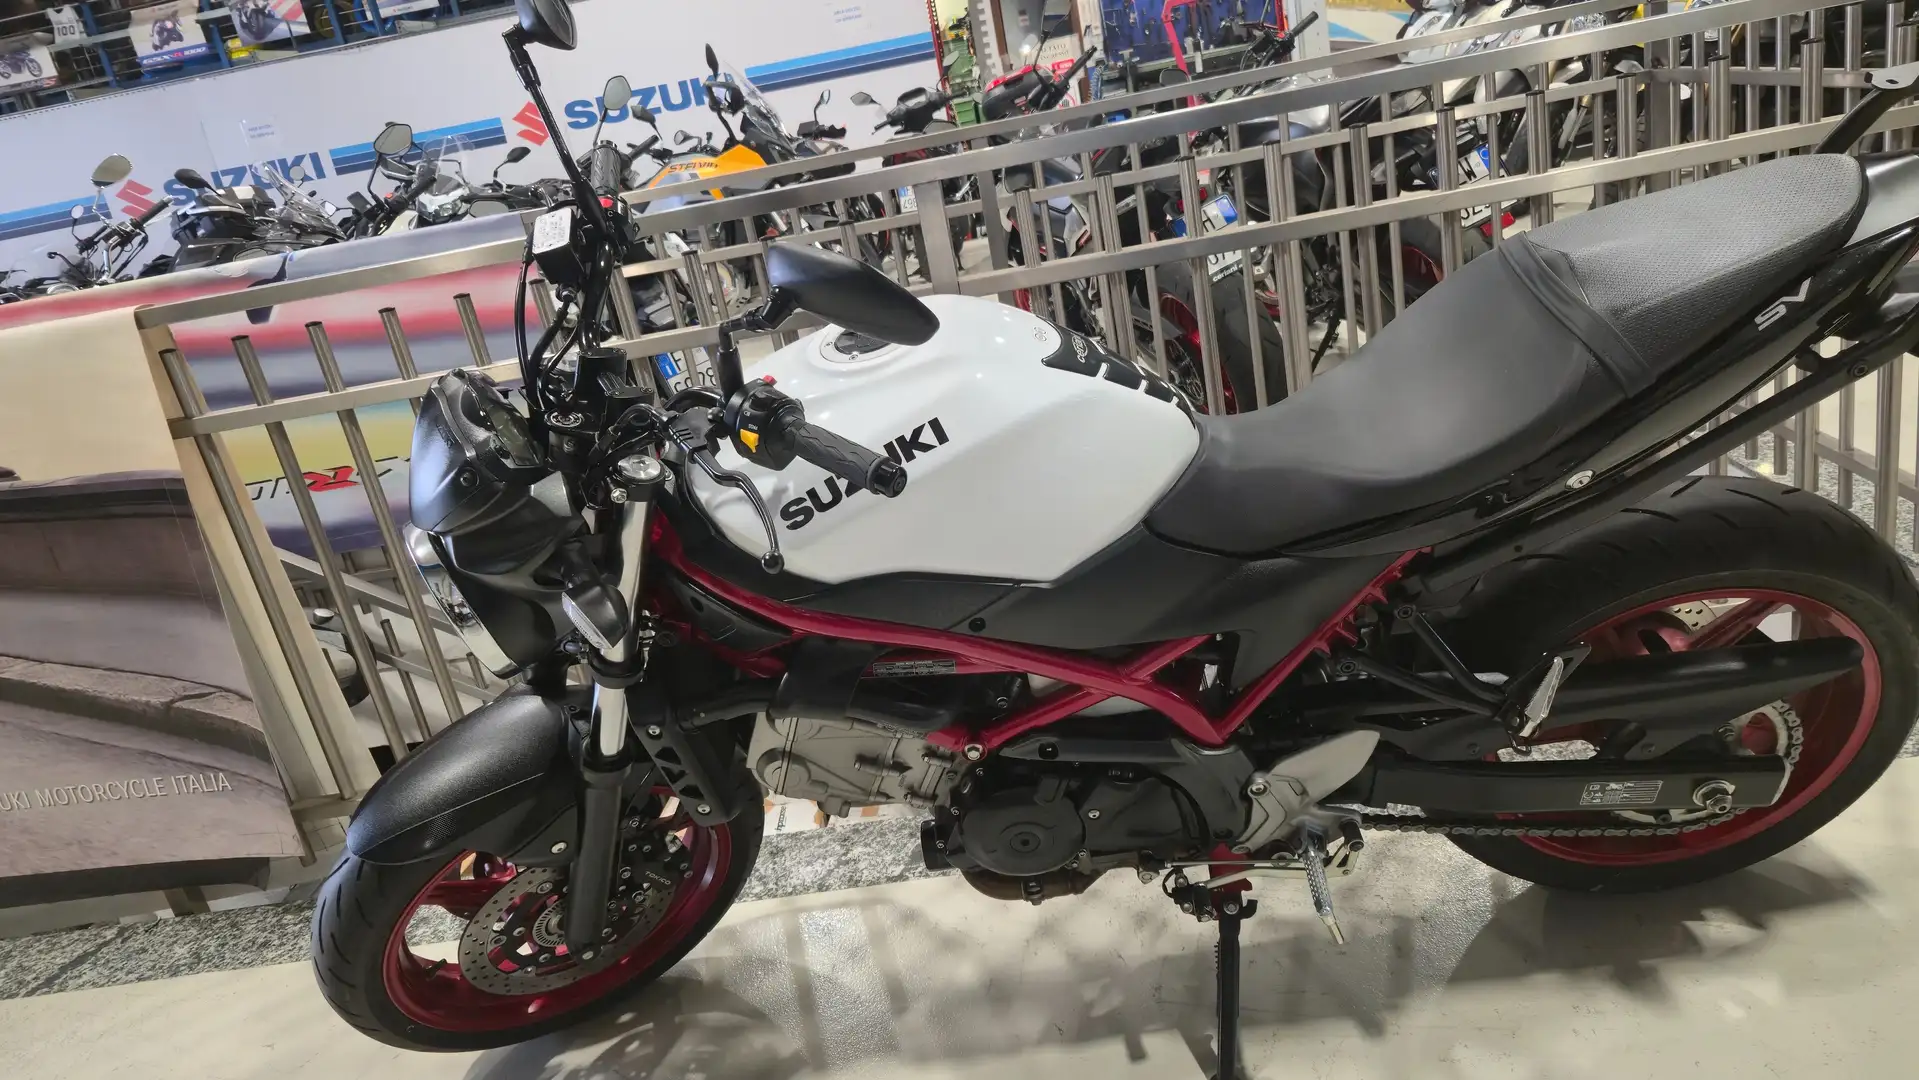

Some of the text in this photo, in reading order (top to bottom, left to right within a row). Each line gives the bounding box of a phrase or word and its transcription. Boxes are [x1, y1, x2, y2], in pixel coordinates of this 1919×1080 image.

[57, 24, 76, 37] 100
[1754, 275, 1812, 332] SV
[34, 777, 168, 808] MOTORCYCLE
[171, 771, 233, 796] ITALIA
